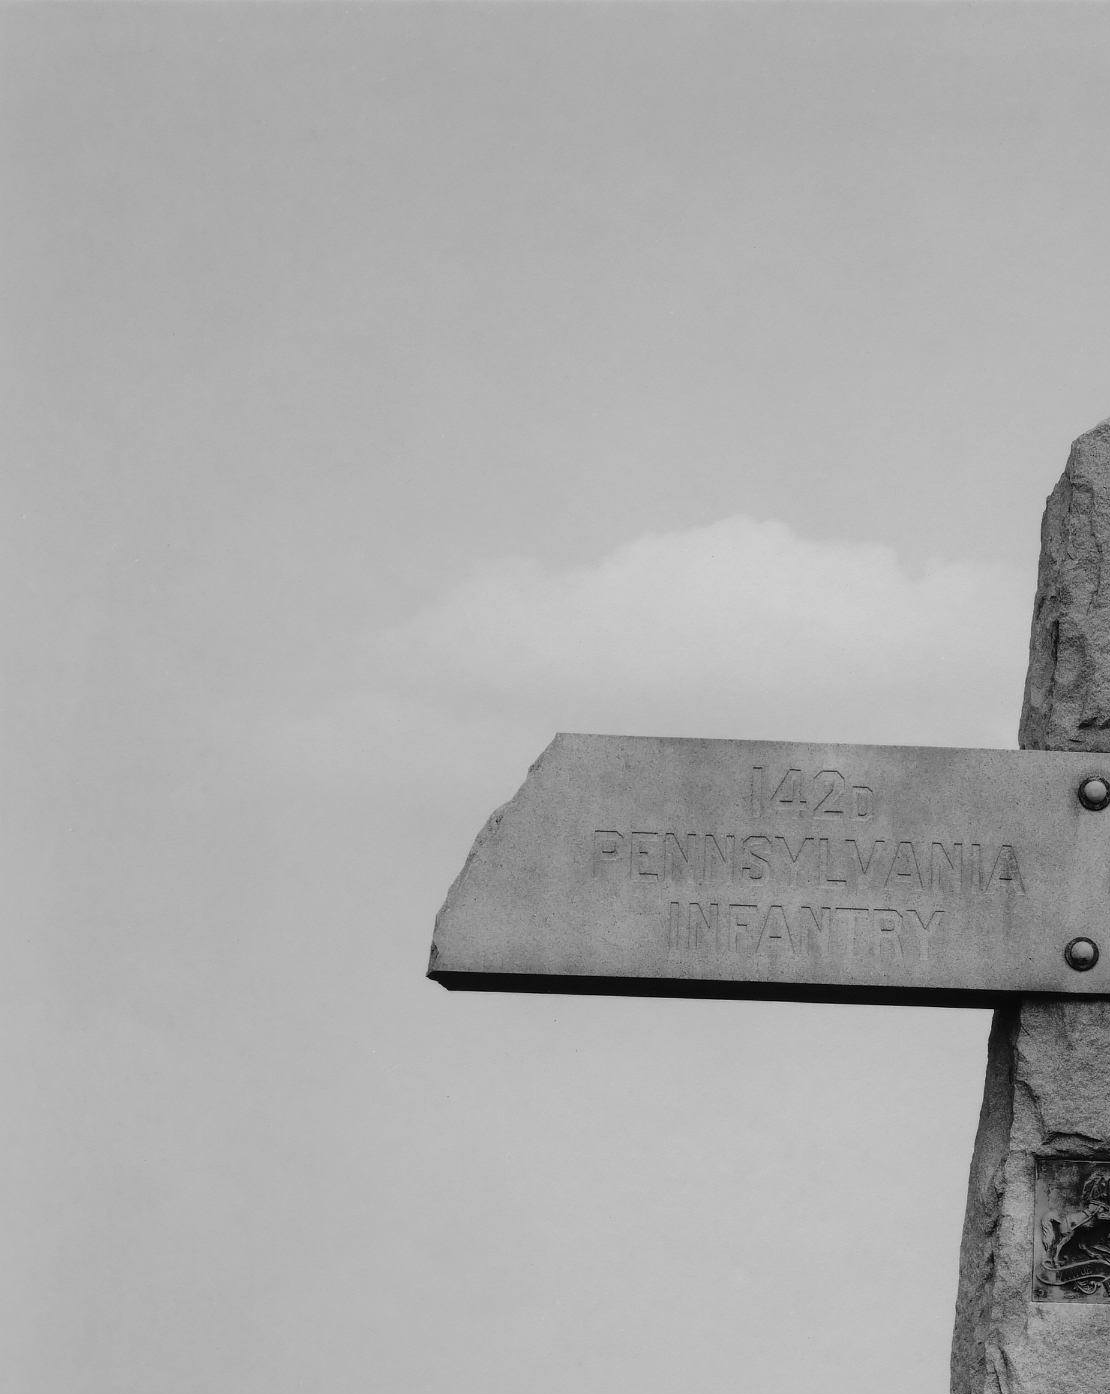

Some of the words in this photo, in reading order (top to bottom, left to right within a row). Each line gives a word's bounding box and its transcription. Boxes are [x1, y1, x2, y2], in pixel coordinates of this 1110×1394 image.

[751, 766, 875, 822] 142D
[593, 829, 1027, 896] PENNSYLVANIA
[668, 901, 946, 961] INFANTRY
